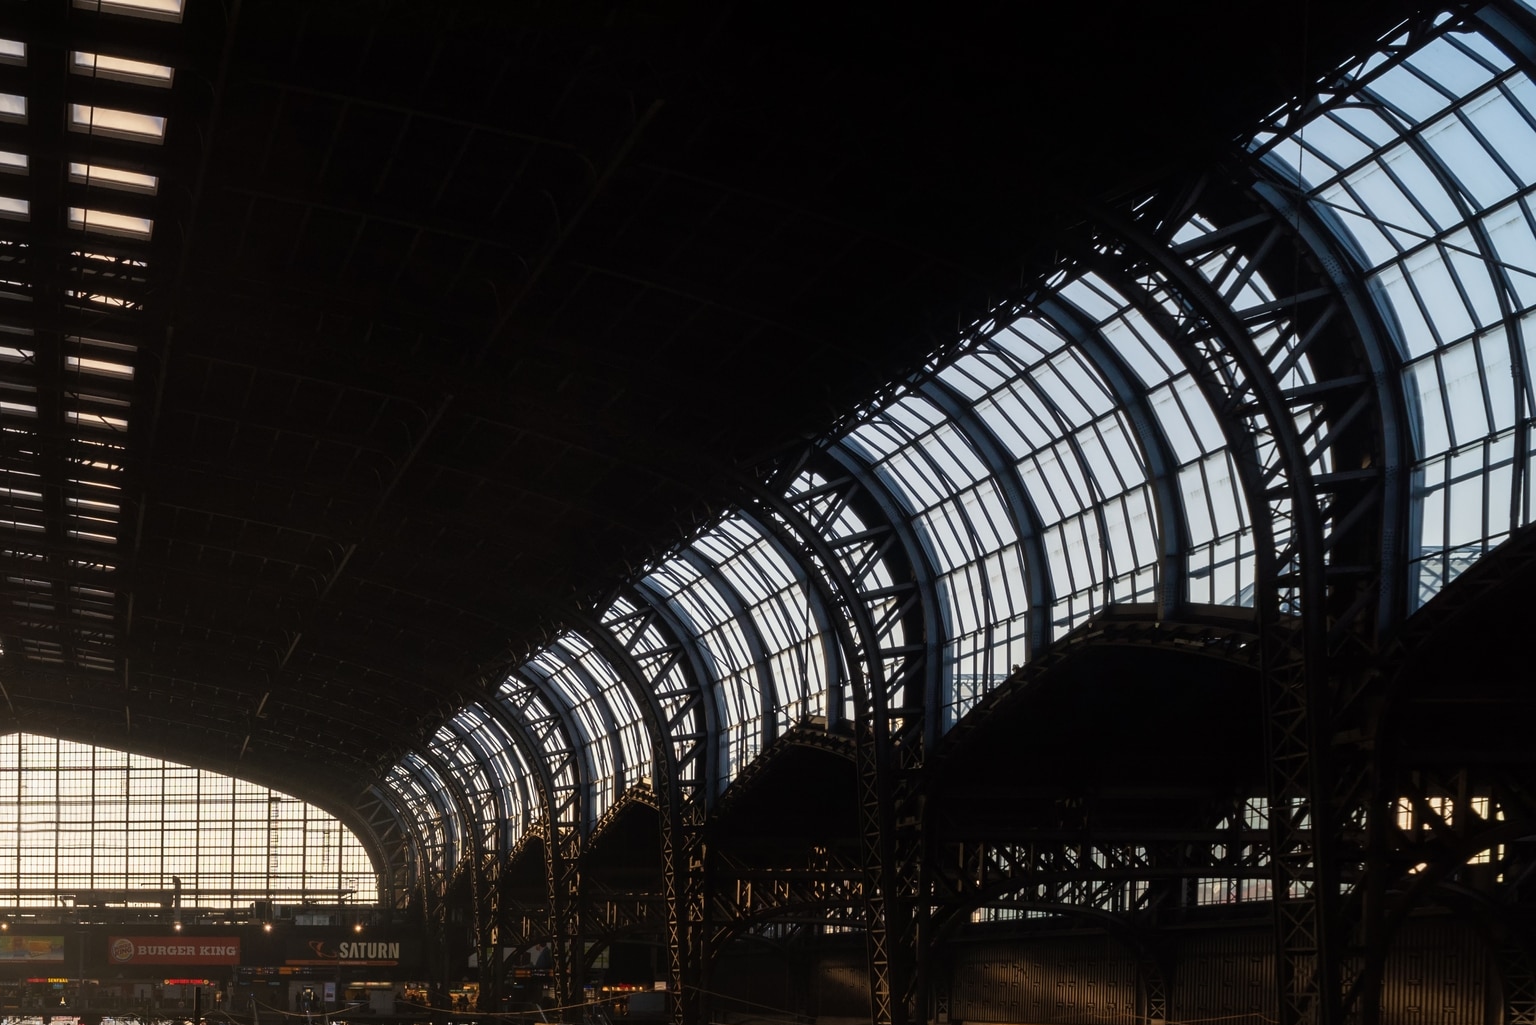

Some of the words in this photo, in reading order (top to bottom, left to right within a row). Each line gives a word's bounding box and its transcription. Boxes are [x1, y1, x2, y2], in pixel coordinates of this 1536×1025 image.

[138, 945, 196, 956] BURGER
[199, 945, 237, 956] KING
[340, 942, 400, 959] SATURN
